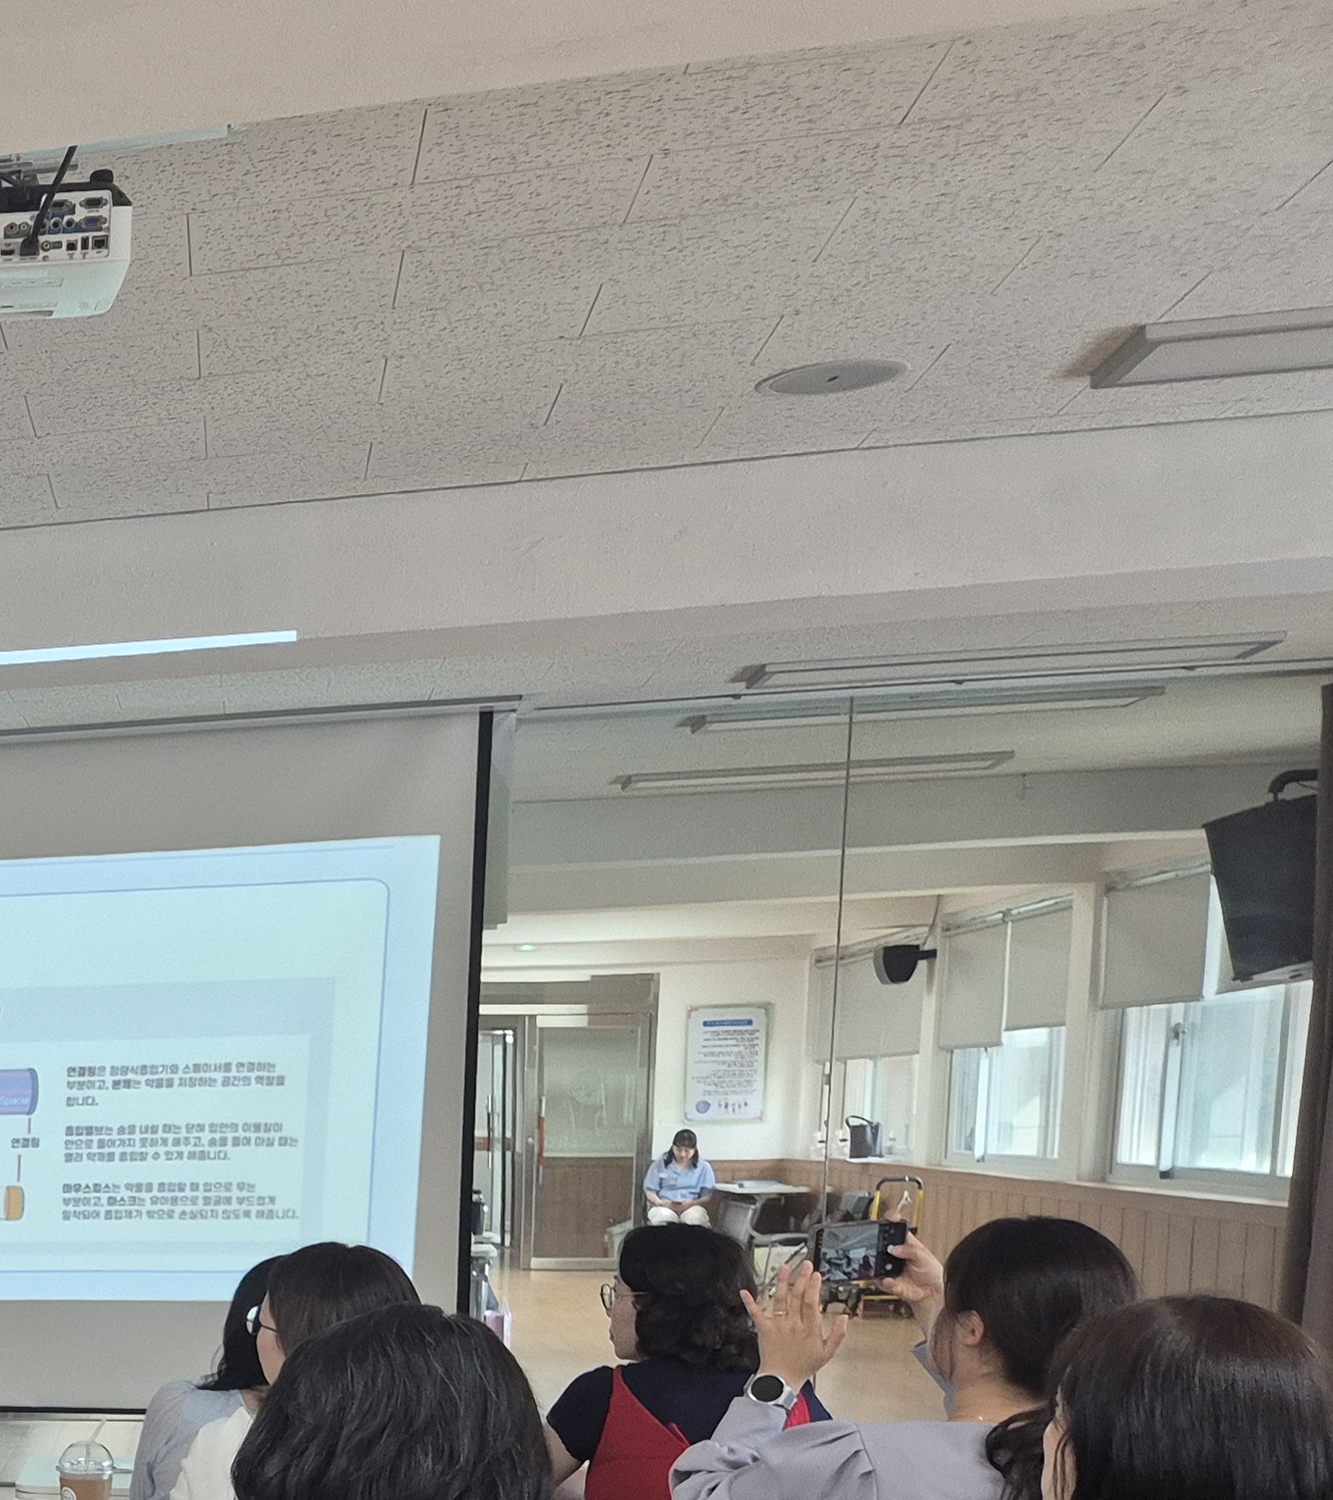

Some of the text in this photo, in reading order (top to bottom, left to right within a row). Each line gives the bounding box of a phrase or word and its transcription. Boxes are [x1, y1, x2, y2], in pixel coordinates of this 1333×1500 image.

[235, 1061, 276, 1073] 연결하는
[64, 1139, 93, 1150] 안으로
[139, 1137, 168, 1149] 못하게
[151, 1151, 160, 1161] 수
[164, 1150, 183, 1161] 있게
[190, 1182, 199, 1193] 때
[203, 1182, 233, 1193] 입으로
